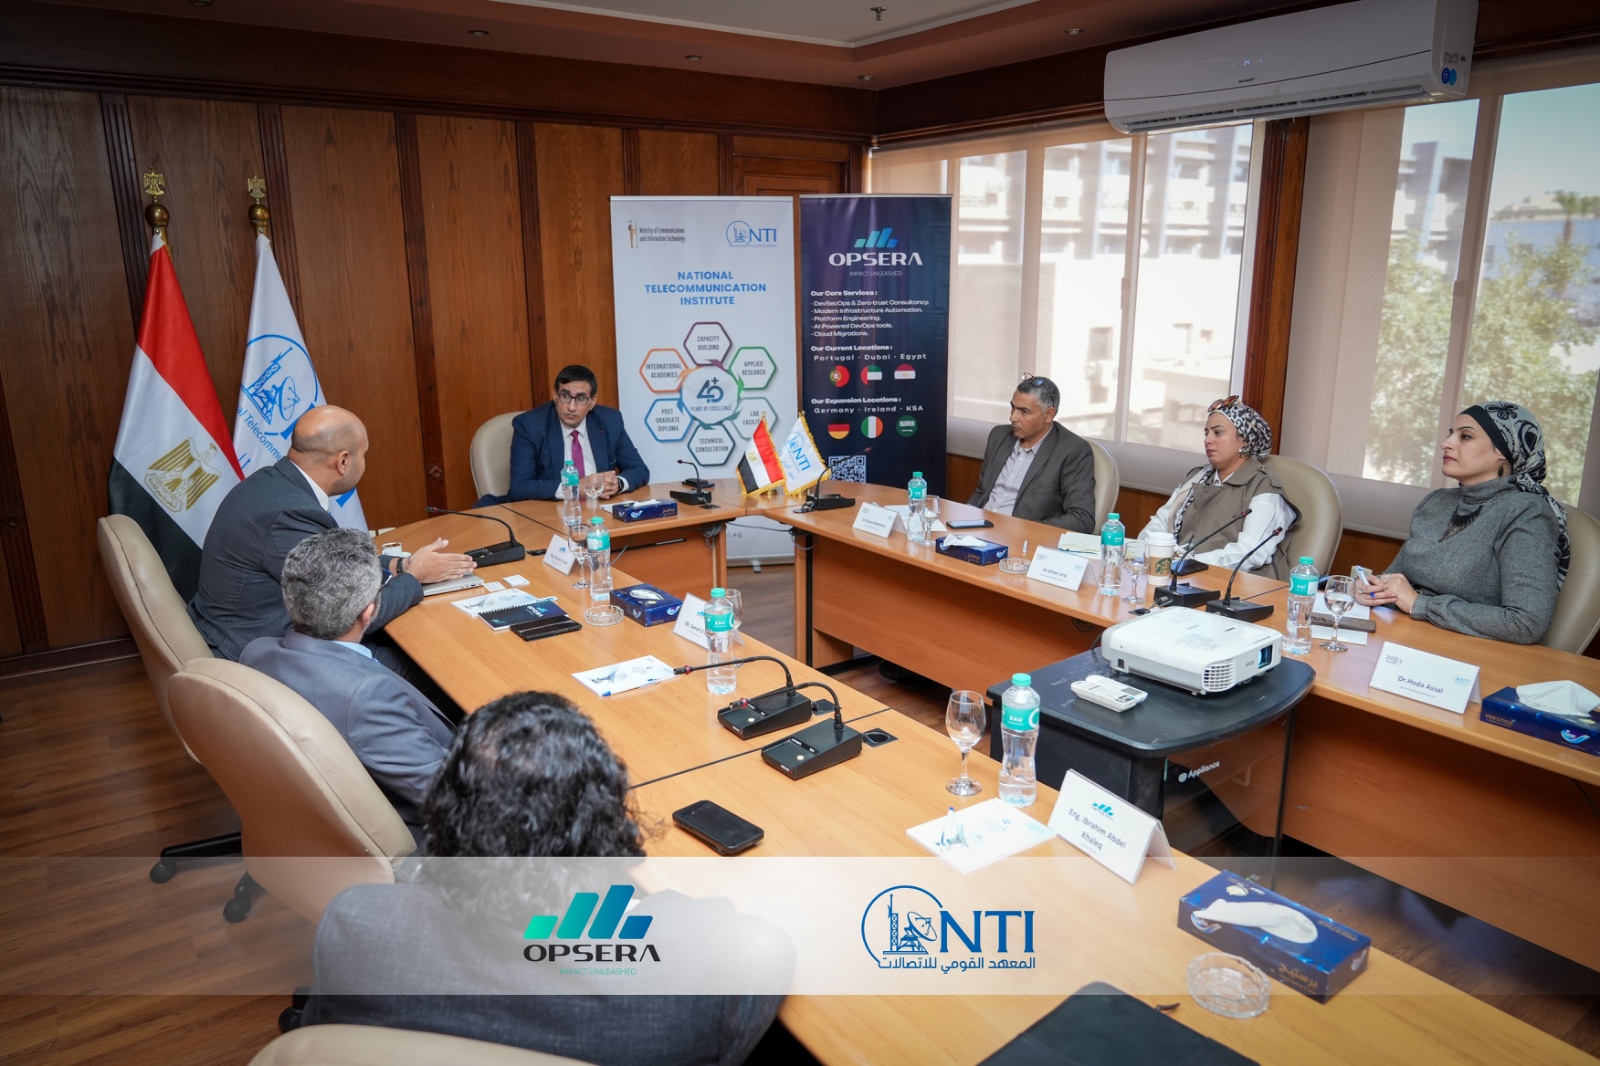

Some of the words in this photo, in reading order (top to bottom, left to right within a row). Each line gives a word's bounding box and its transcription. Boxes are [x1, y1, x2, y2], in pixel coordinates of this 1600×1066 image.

[667, 235, 686, 243] Technology
[749, 228, 777, 242] NTI
[828, 252, 923, 266] OPSERA
[678, 271, 734, 280] NATIONAL
[644, 283, 766, 293] TELECOMMUNICATION
[680, 296, 735, 305] INSTITUTE
[793, 448, 810, 470] NTI
[1426, 684, 1443, 693] Assal
[1188, 762, 1220, 778] Appliance
[1069, 808, 1081, 821] Eng.
[1082, 817, 1106, 836] Ibrahim
[1107, 832, 1126, 848] Abdel
[1081, 831, 1103, 851] Khaleq
